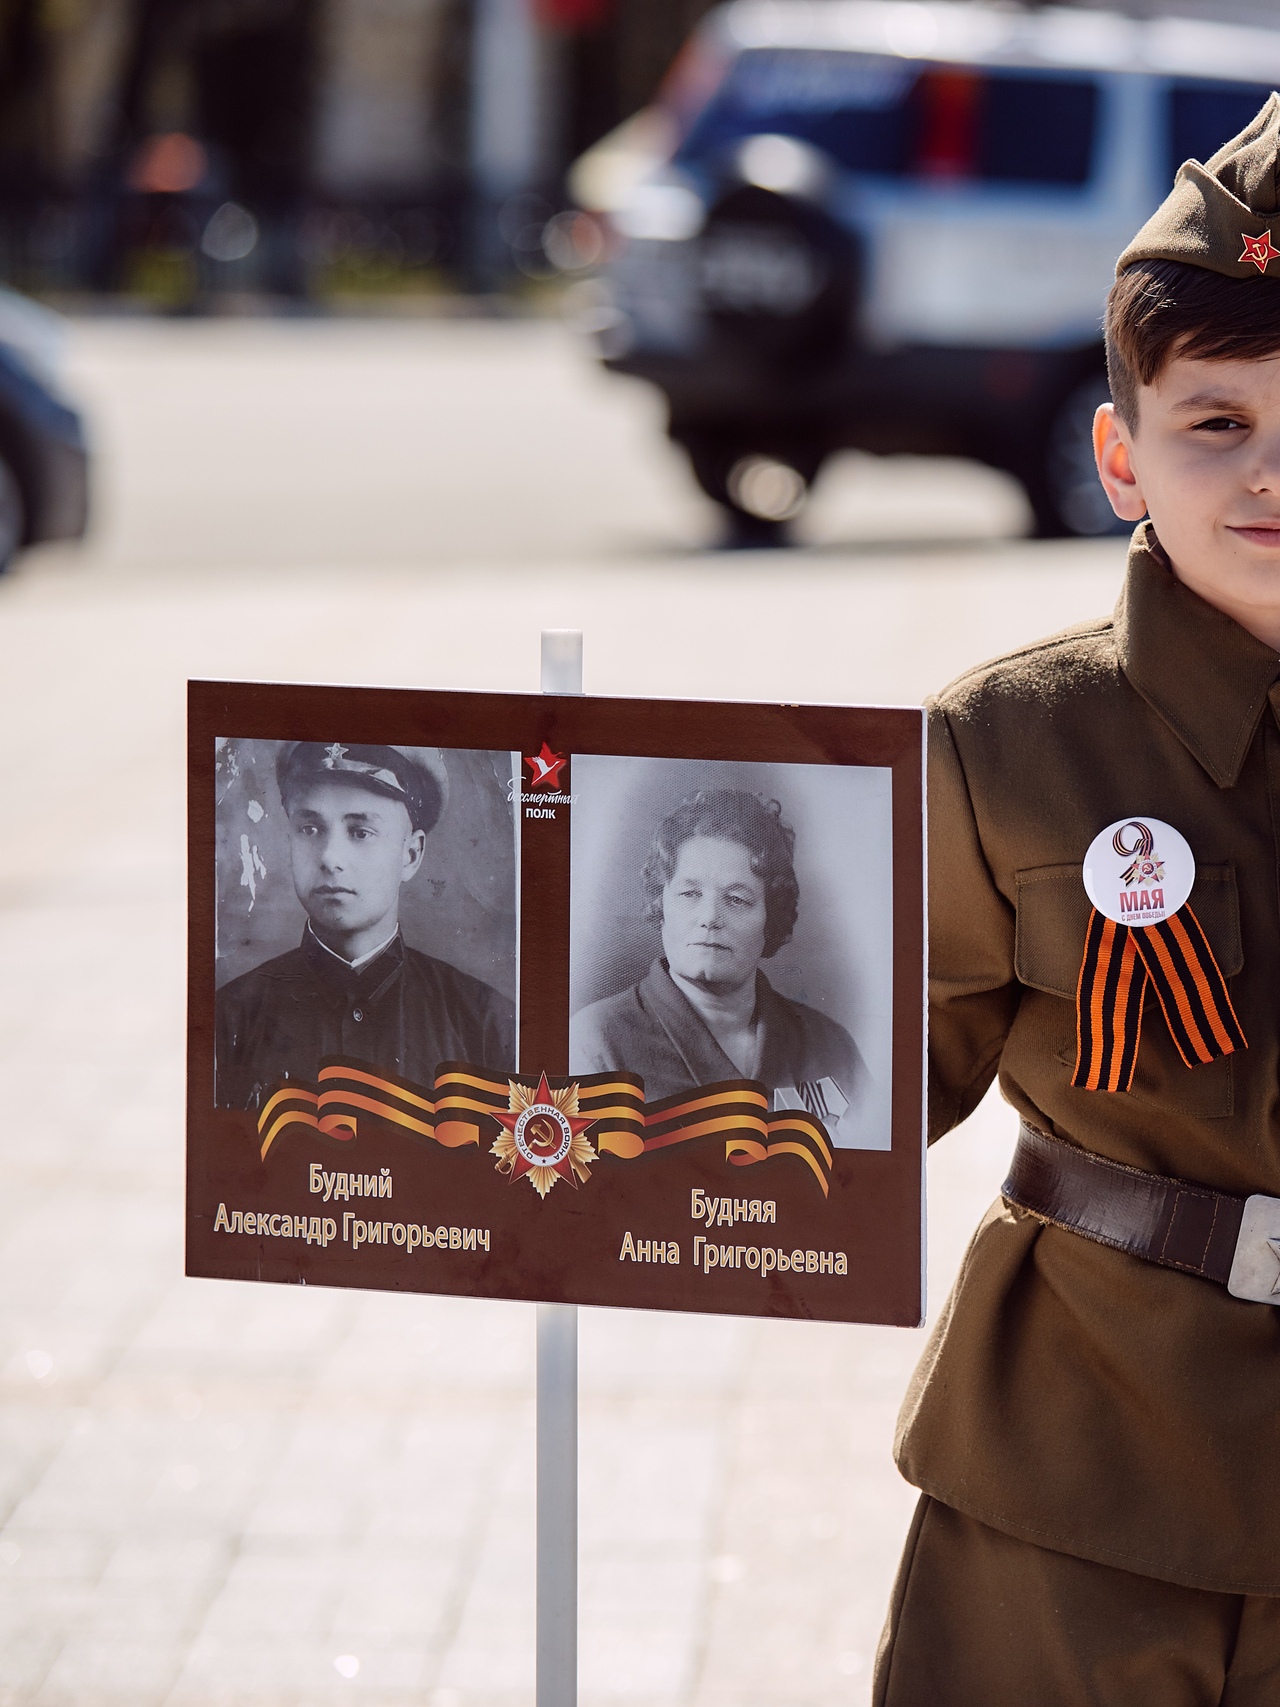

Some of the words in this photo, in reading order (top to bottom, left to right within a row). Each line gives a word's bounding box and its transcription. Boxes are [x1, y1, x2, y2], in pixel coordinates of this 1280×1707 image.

[525, 808, 556, 819] ПОЛК
[1120, 888, 1164, 912] МАЯ
[517, 1105, 566, 1160] ОТЕЧЕСТВЕННАЯ
[309, 1163, 393, 1202] Будний
[691, 1189, 776, 1227] Будняя
[213, 1203, 337, 1247] Александр
[342, 1212, 491, 1254] Григорьевич
[619, 1231, 680, 1265] Анна
[693, 1236, 848, 1278] Григорьевна
